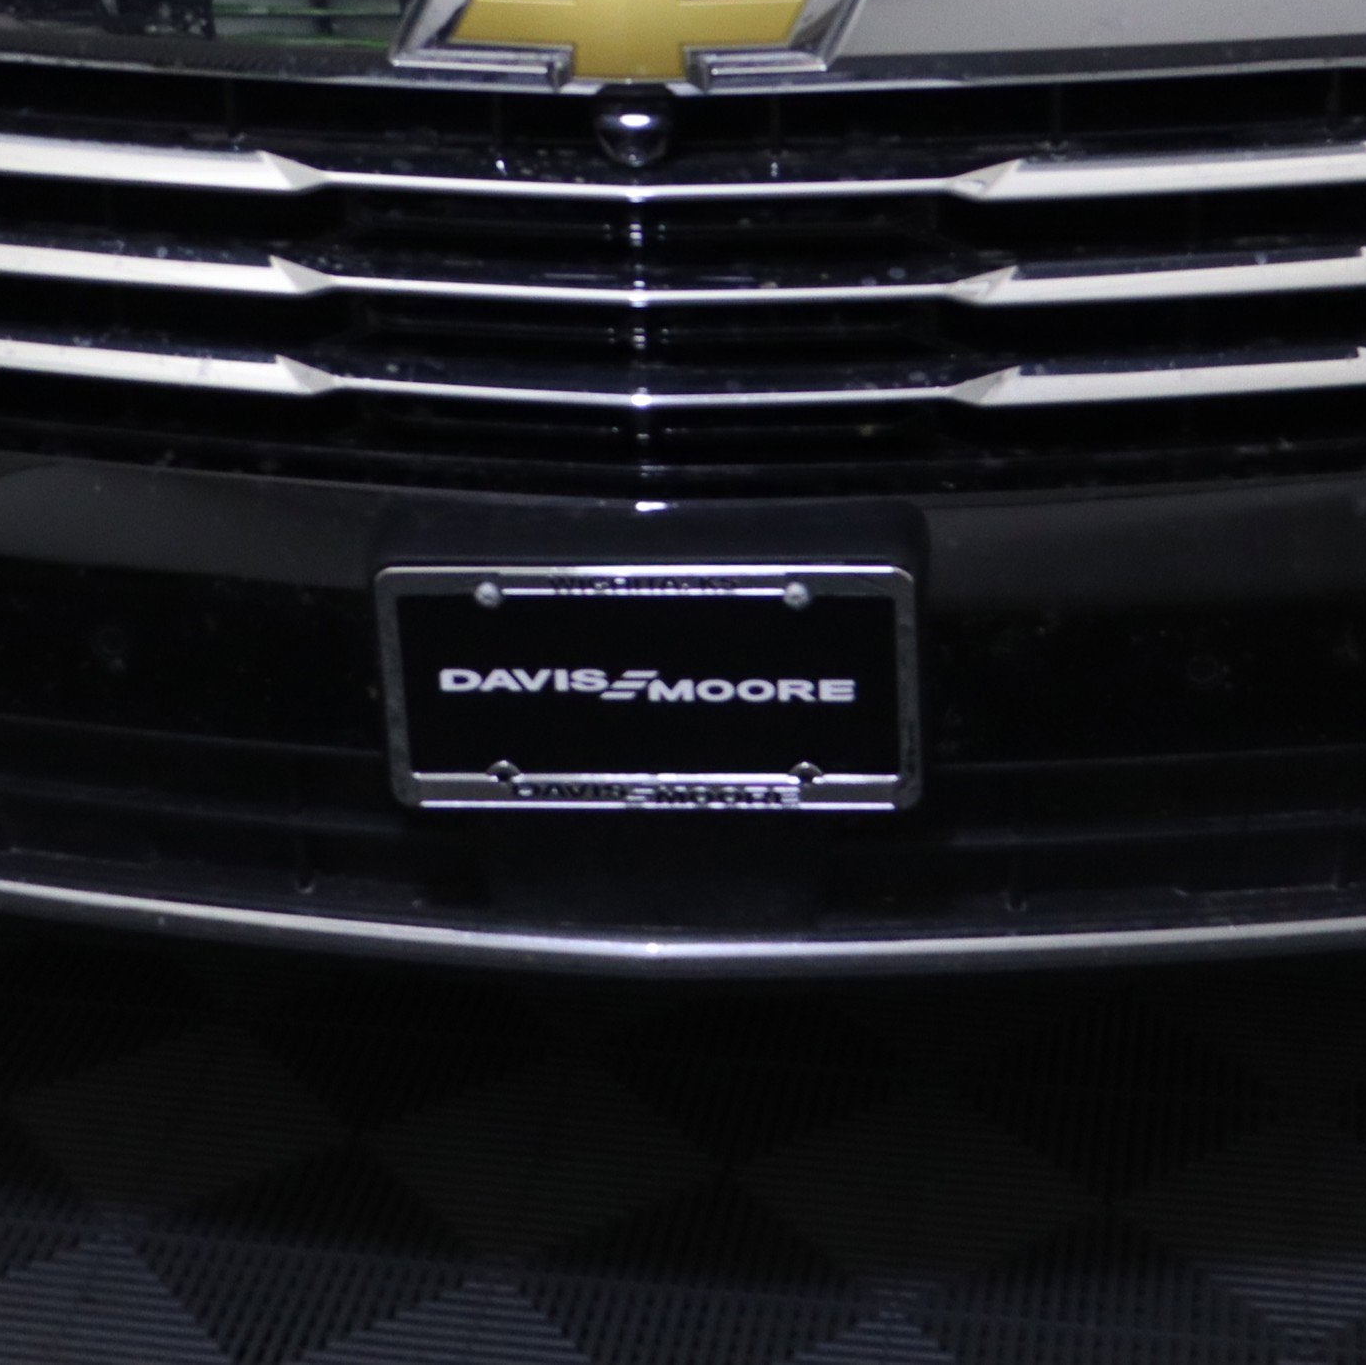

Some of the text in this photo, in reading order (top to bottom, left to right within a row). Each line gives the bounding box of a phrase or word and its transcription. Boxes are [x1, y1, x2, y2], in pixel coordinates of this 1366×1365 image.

[438, 668, 856, 702] DAVIS MOORE
[512, 784, 623, 803] DAVIS
